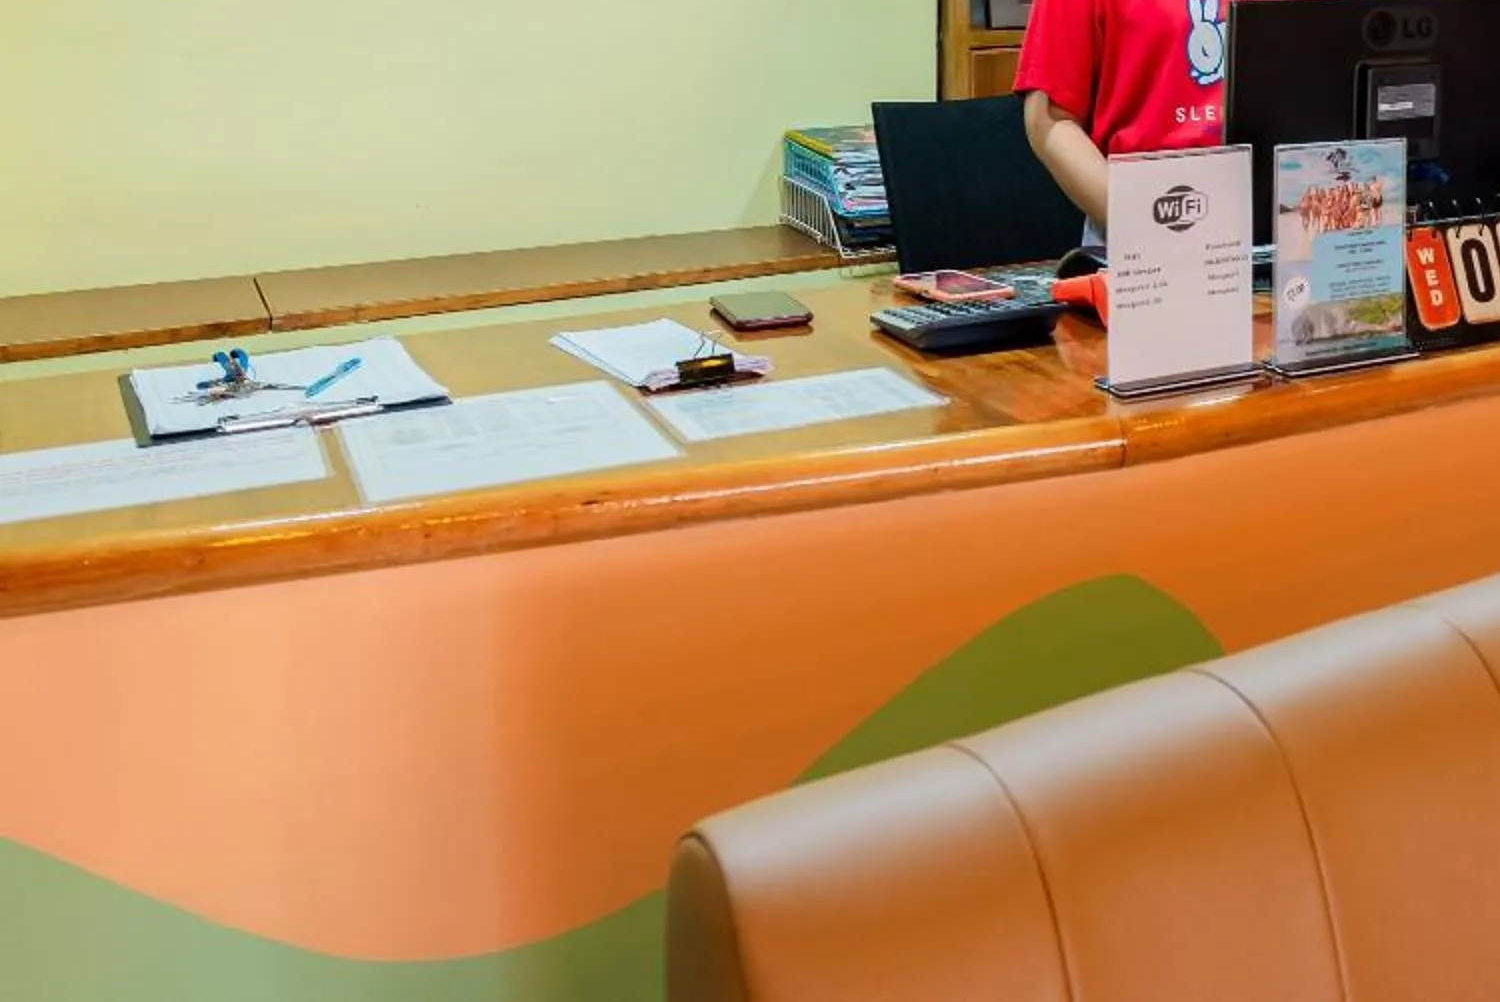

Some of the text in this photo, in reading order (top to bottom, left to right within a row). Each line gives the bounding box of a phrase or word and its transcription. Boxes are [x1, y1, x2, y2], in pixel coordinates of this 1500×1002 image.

[1402, 18, 1434, 39] LG
[1175, 105, 1223, 124] SLE
[1156, 197, 1202, 219] WiFi
[1416, 248, 1443, 307] WED
